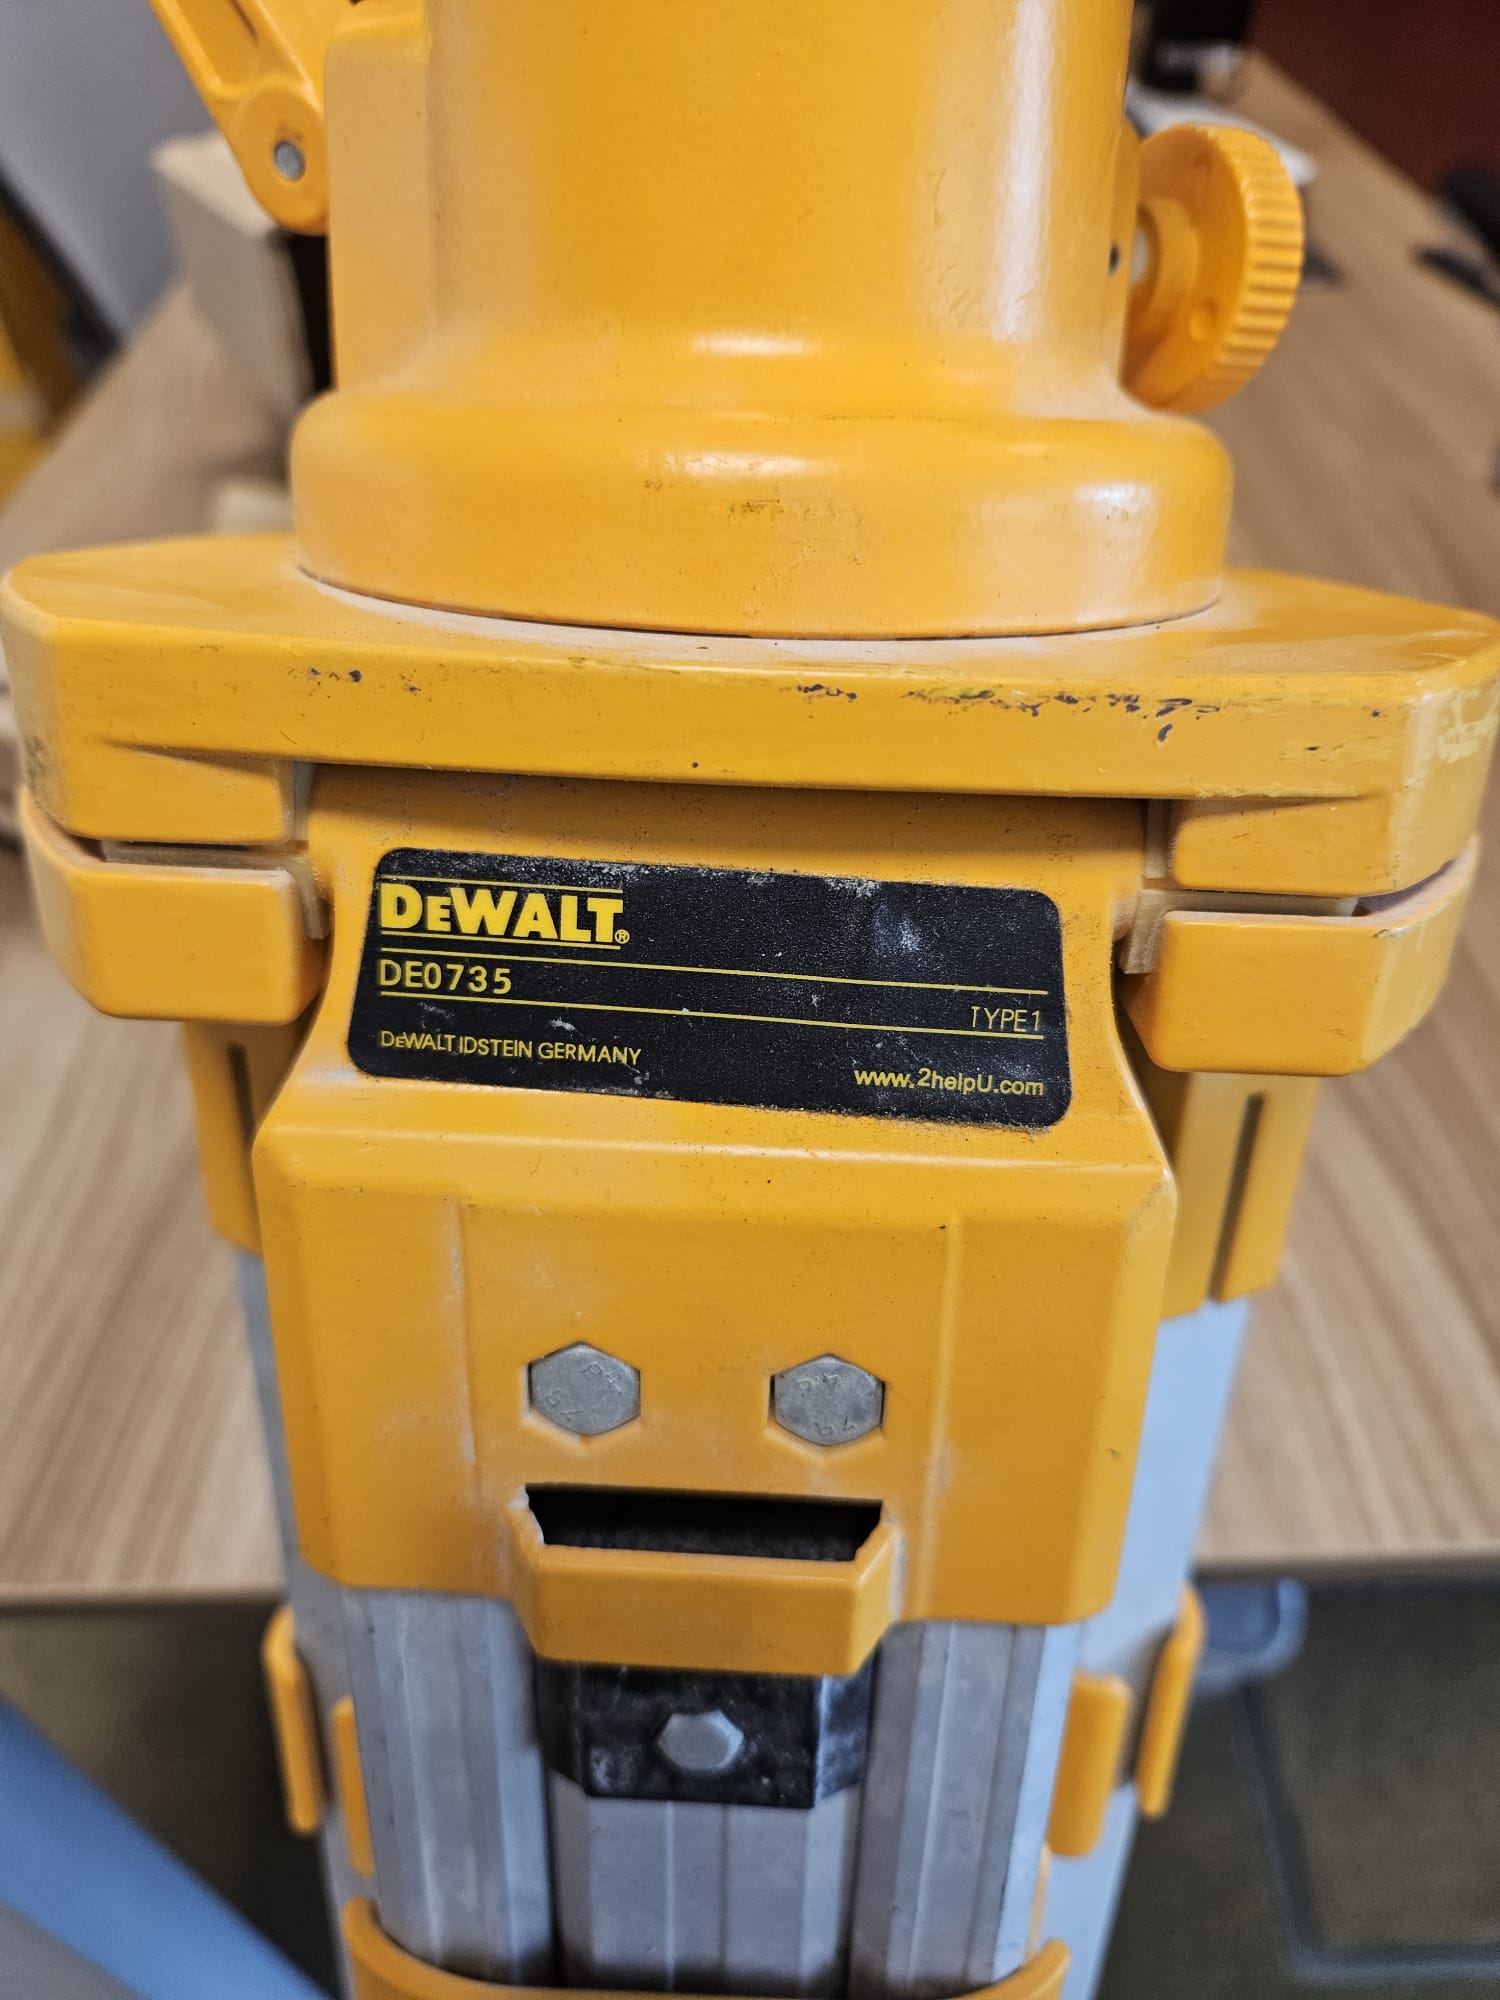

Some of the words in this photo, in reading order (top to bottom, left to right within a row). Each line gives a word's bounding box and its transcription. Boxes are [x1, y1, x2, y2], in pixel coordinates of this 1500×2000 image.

[379, 959, 512, 994] DE0735
[459, 1036, 533, 1058] IDSTEIN
[538, 1042, 642, 1065] GERMANY
[854, 1067, 1045, 1096] www.2helpU.com
